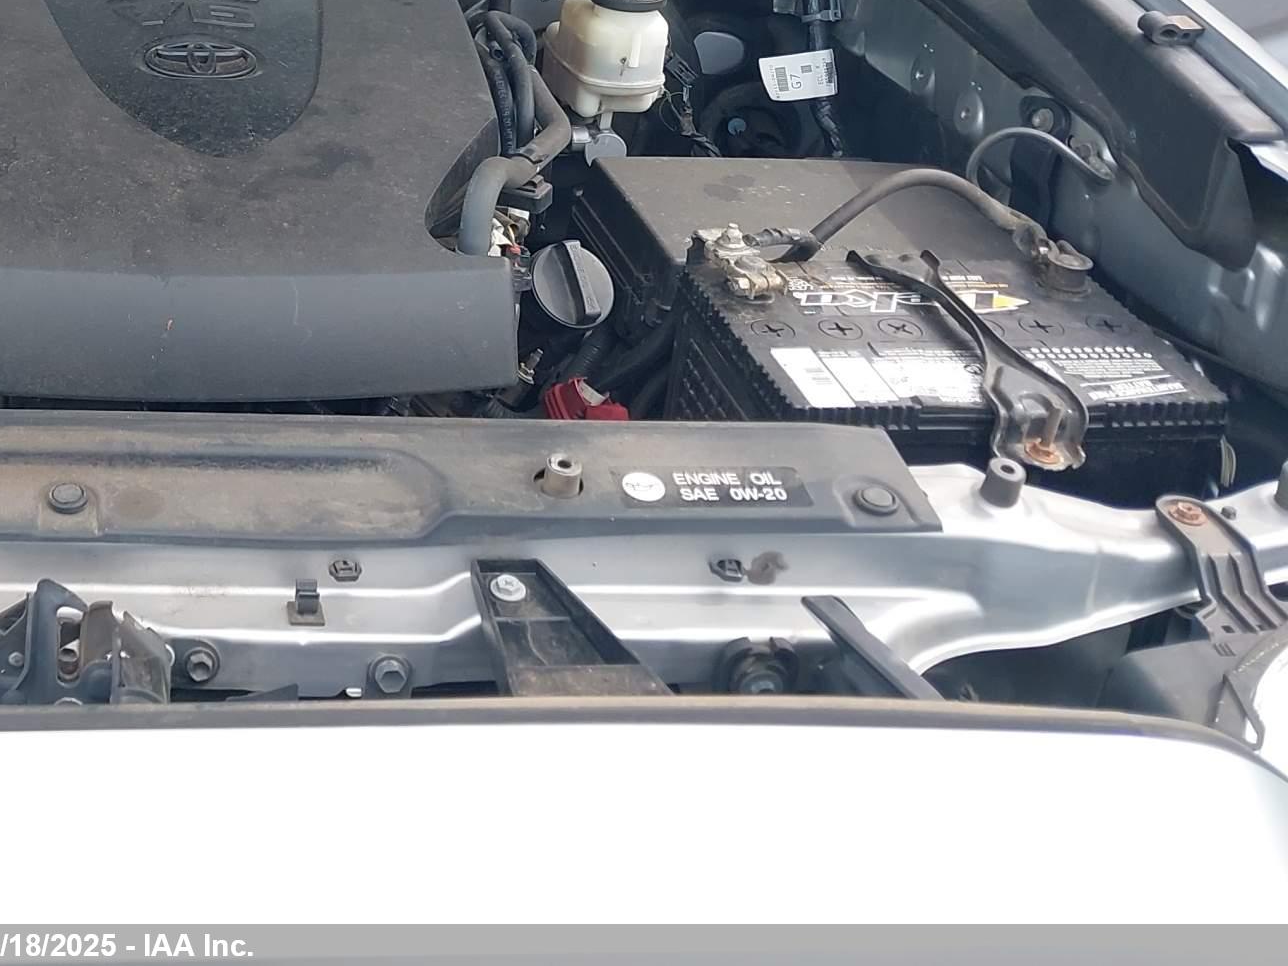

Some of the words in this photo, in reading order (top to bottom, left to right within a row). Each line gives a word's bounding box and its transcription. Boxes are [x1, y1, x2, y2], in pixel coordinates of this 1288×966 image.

[672, 472, 741, 485] ENGINE
[749, 472, 782, 485] OIL
[680, 488, 720, 501] SAE
[729, 488, 788, 501] 0W-20
